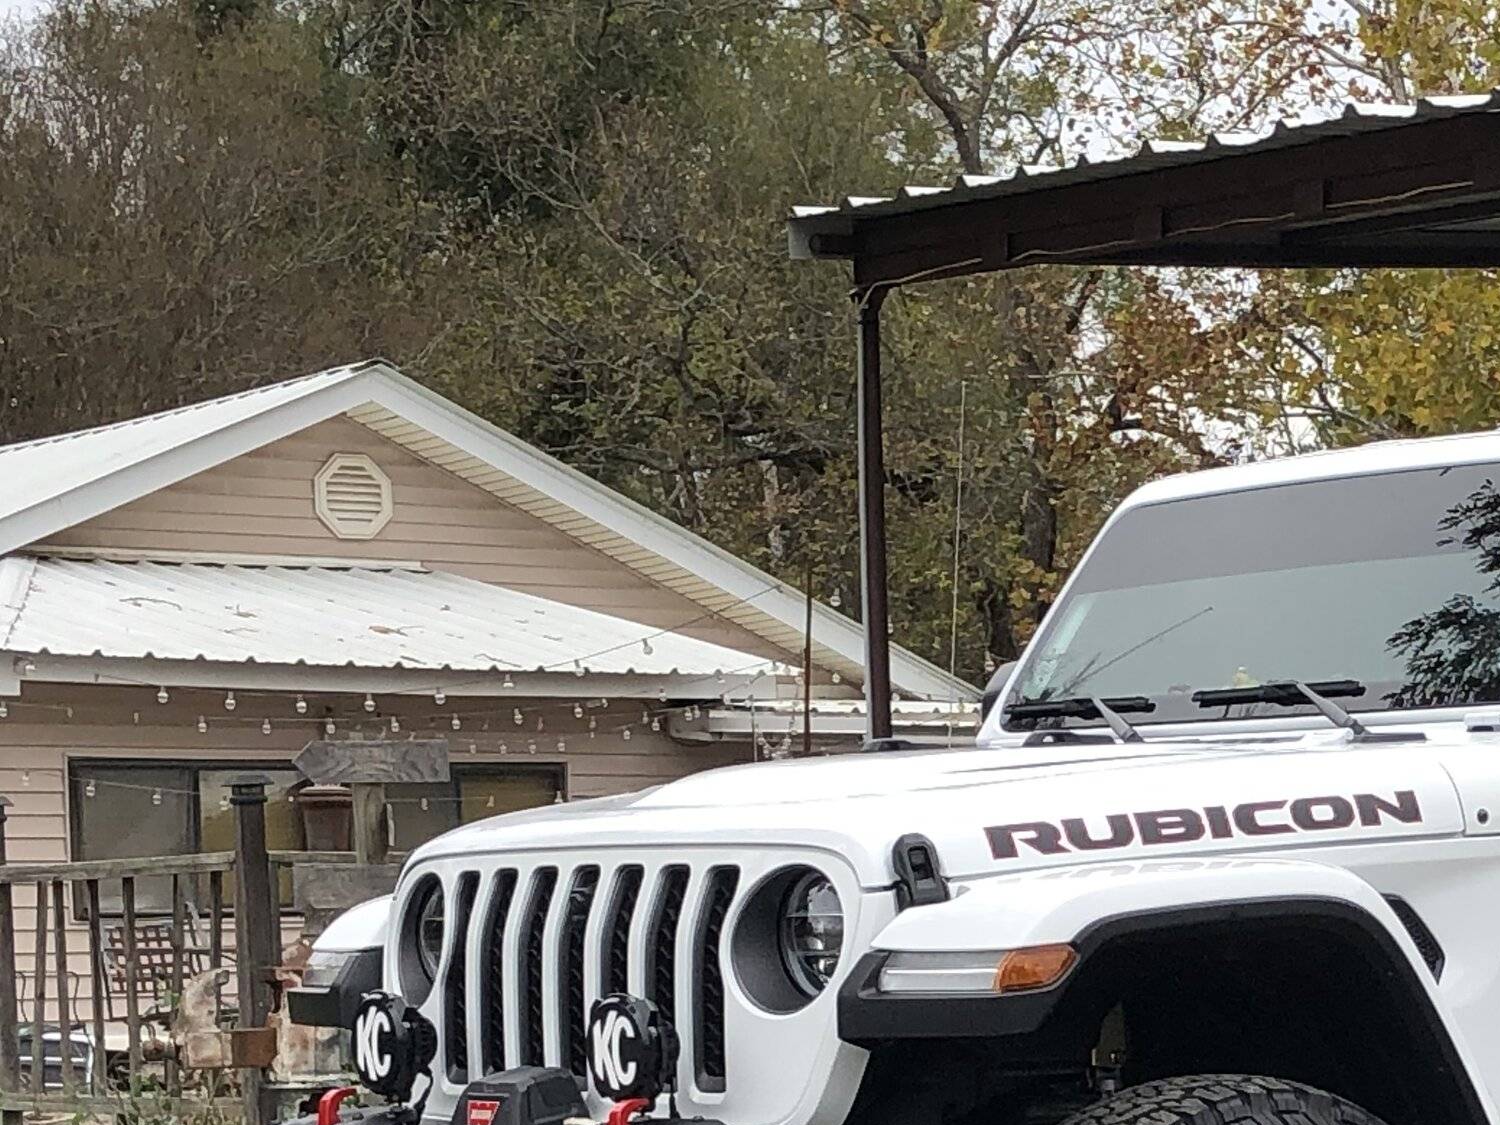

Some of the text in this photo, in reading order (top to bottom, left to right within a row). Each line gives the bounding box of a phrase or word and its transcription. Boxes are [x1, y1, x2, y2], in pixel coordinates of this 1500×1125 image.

[984, 790, 1423, 860] RUBICON
[356, 1005, 392, 1082] KC
[592, 1009, 638, 1091] KC
